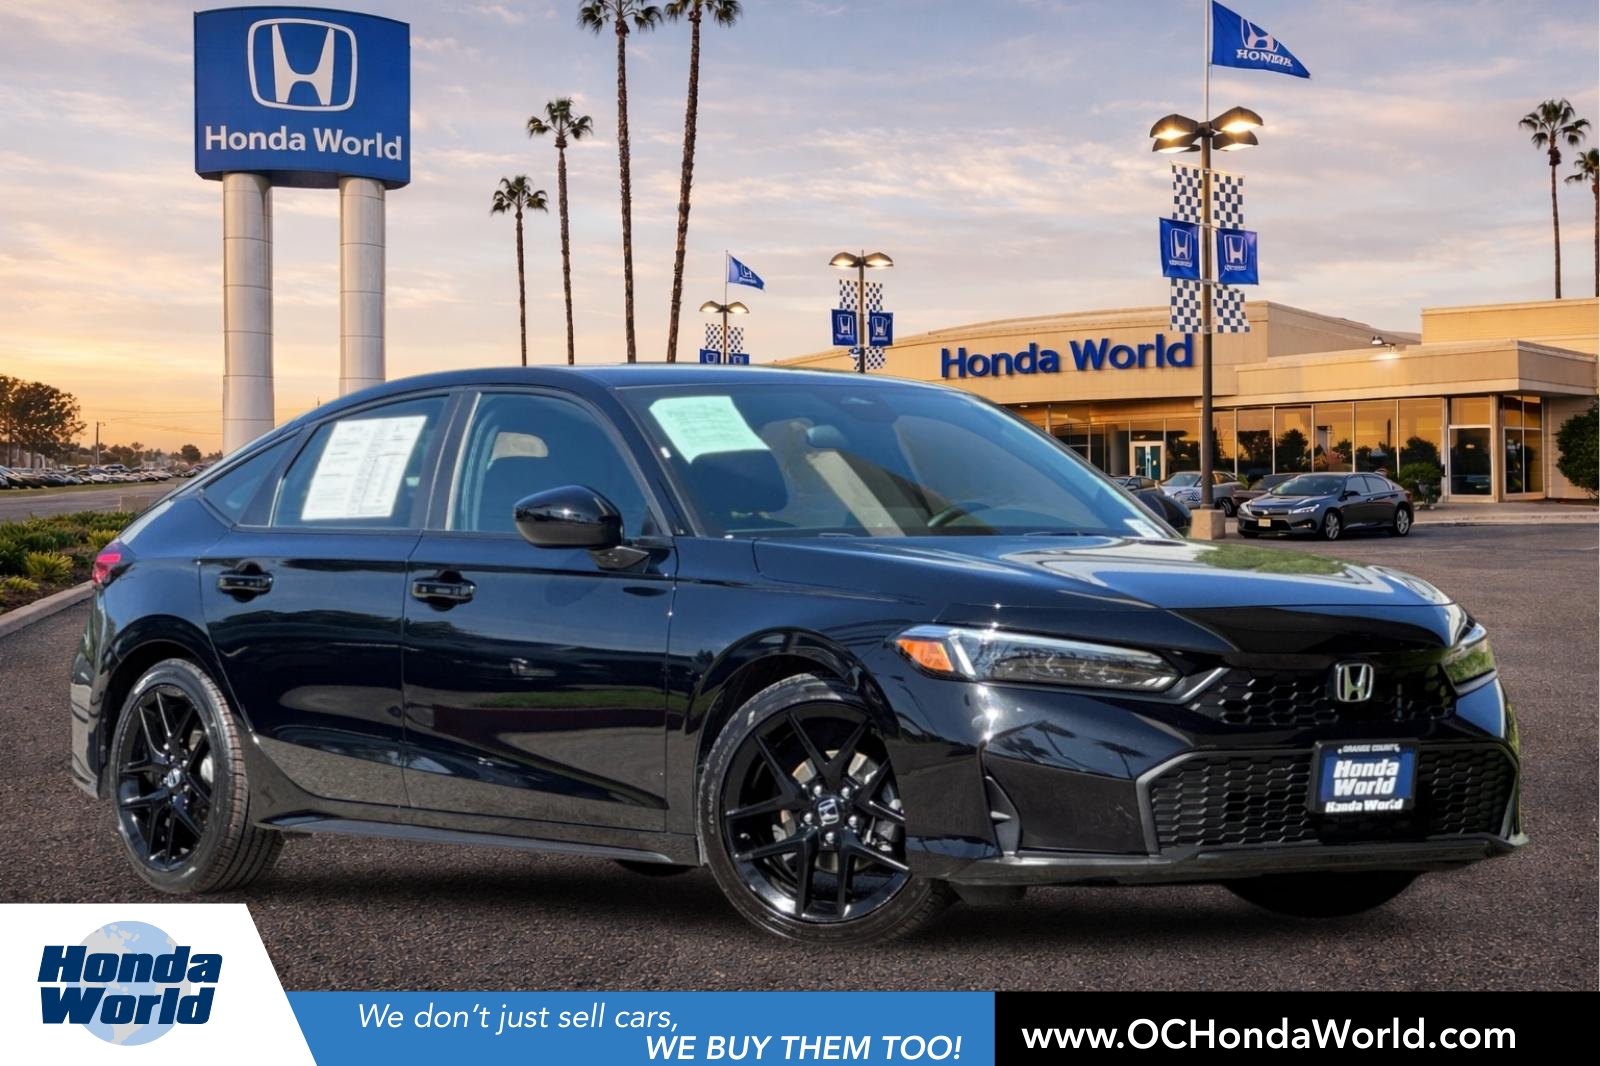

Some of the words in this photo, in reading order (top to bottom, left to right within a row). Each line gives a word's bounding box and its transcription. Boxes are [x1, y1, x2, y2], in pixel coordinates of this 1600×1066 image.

[205, 125, 306, 151] Honda
[313, 127, 402, 161] World
[940, 342, 1060, 378] Honda
[1069, 333, 1194, 371] World
[1342, 744, 1371, 753] ORANGE
[1333, 758, 1399, 778] Honda
[1333, 776, 1397, 796] World
